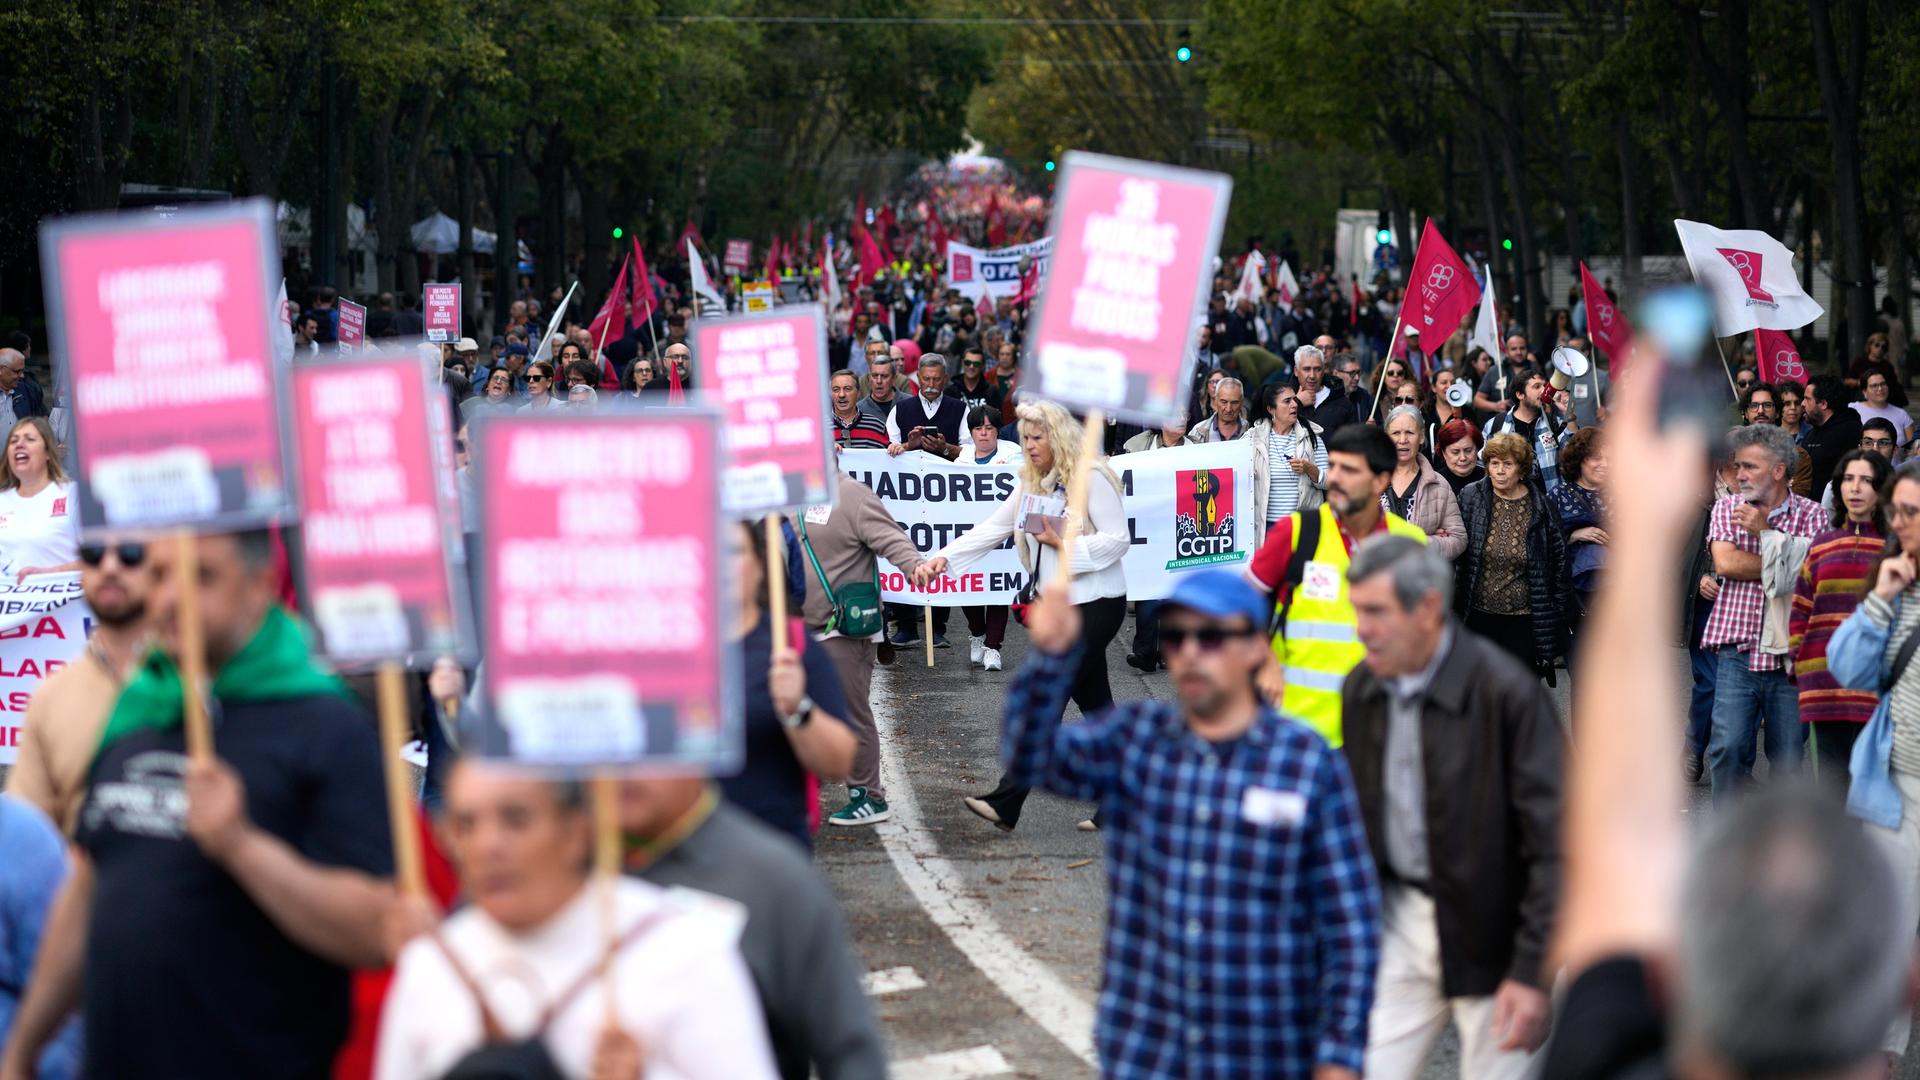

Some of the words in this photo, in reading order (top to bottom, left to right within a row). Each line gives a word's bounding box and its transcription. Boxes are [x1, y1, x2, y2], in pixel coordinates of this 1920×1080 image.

[1178, 535, 1232, 557] CGTP
[1169, 557, 1211, 568] INTERSINDICAL
[1212, 553, 1241, 563] NACIONAL
[990, 572, 1022, 592] EM
